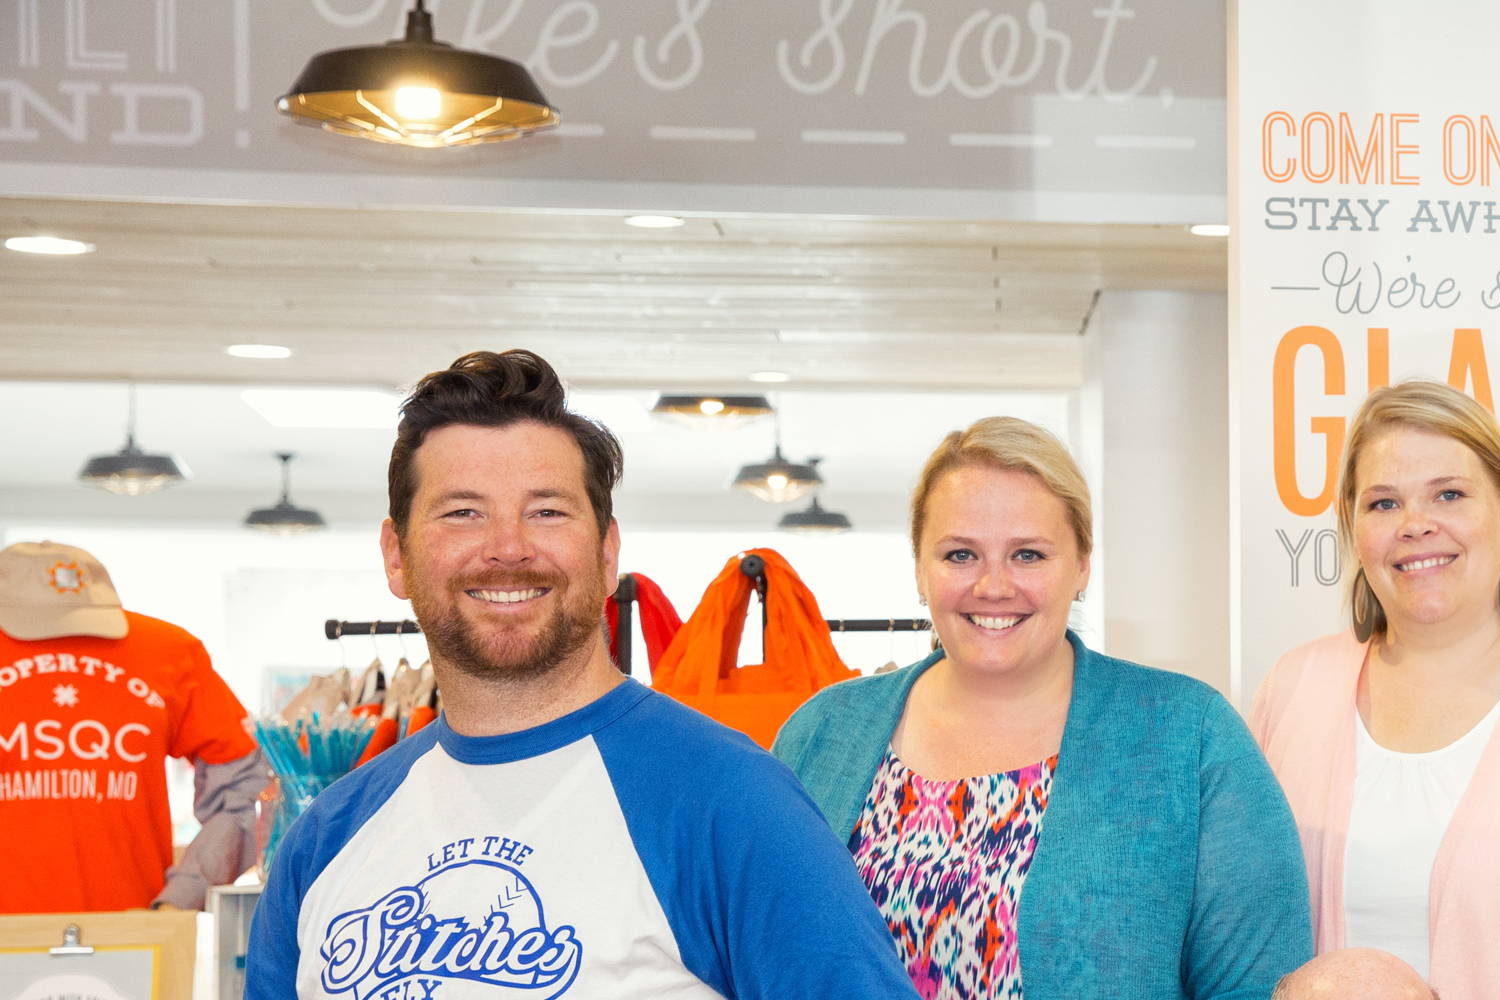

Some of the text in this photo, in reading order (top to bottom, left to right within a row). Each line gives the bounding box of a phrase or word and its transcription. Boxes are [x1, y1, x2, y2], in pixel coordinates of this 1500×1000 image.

[1261, 111, 1421, 187] COME
[1264, 197, 1390, 232] STAY
[1321, 251, 1461, 315] We're
[1274, 528, 1343, 588] YO
[107, 771, 138, 801] MO
[427, 836, 534, 872] LET THE
[320, 886, 582, 995] Stitches
